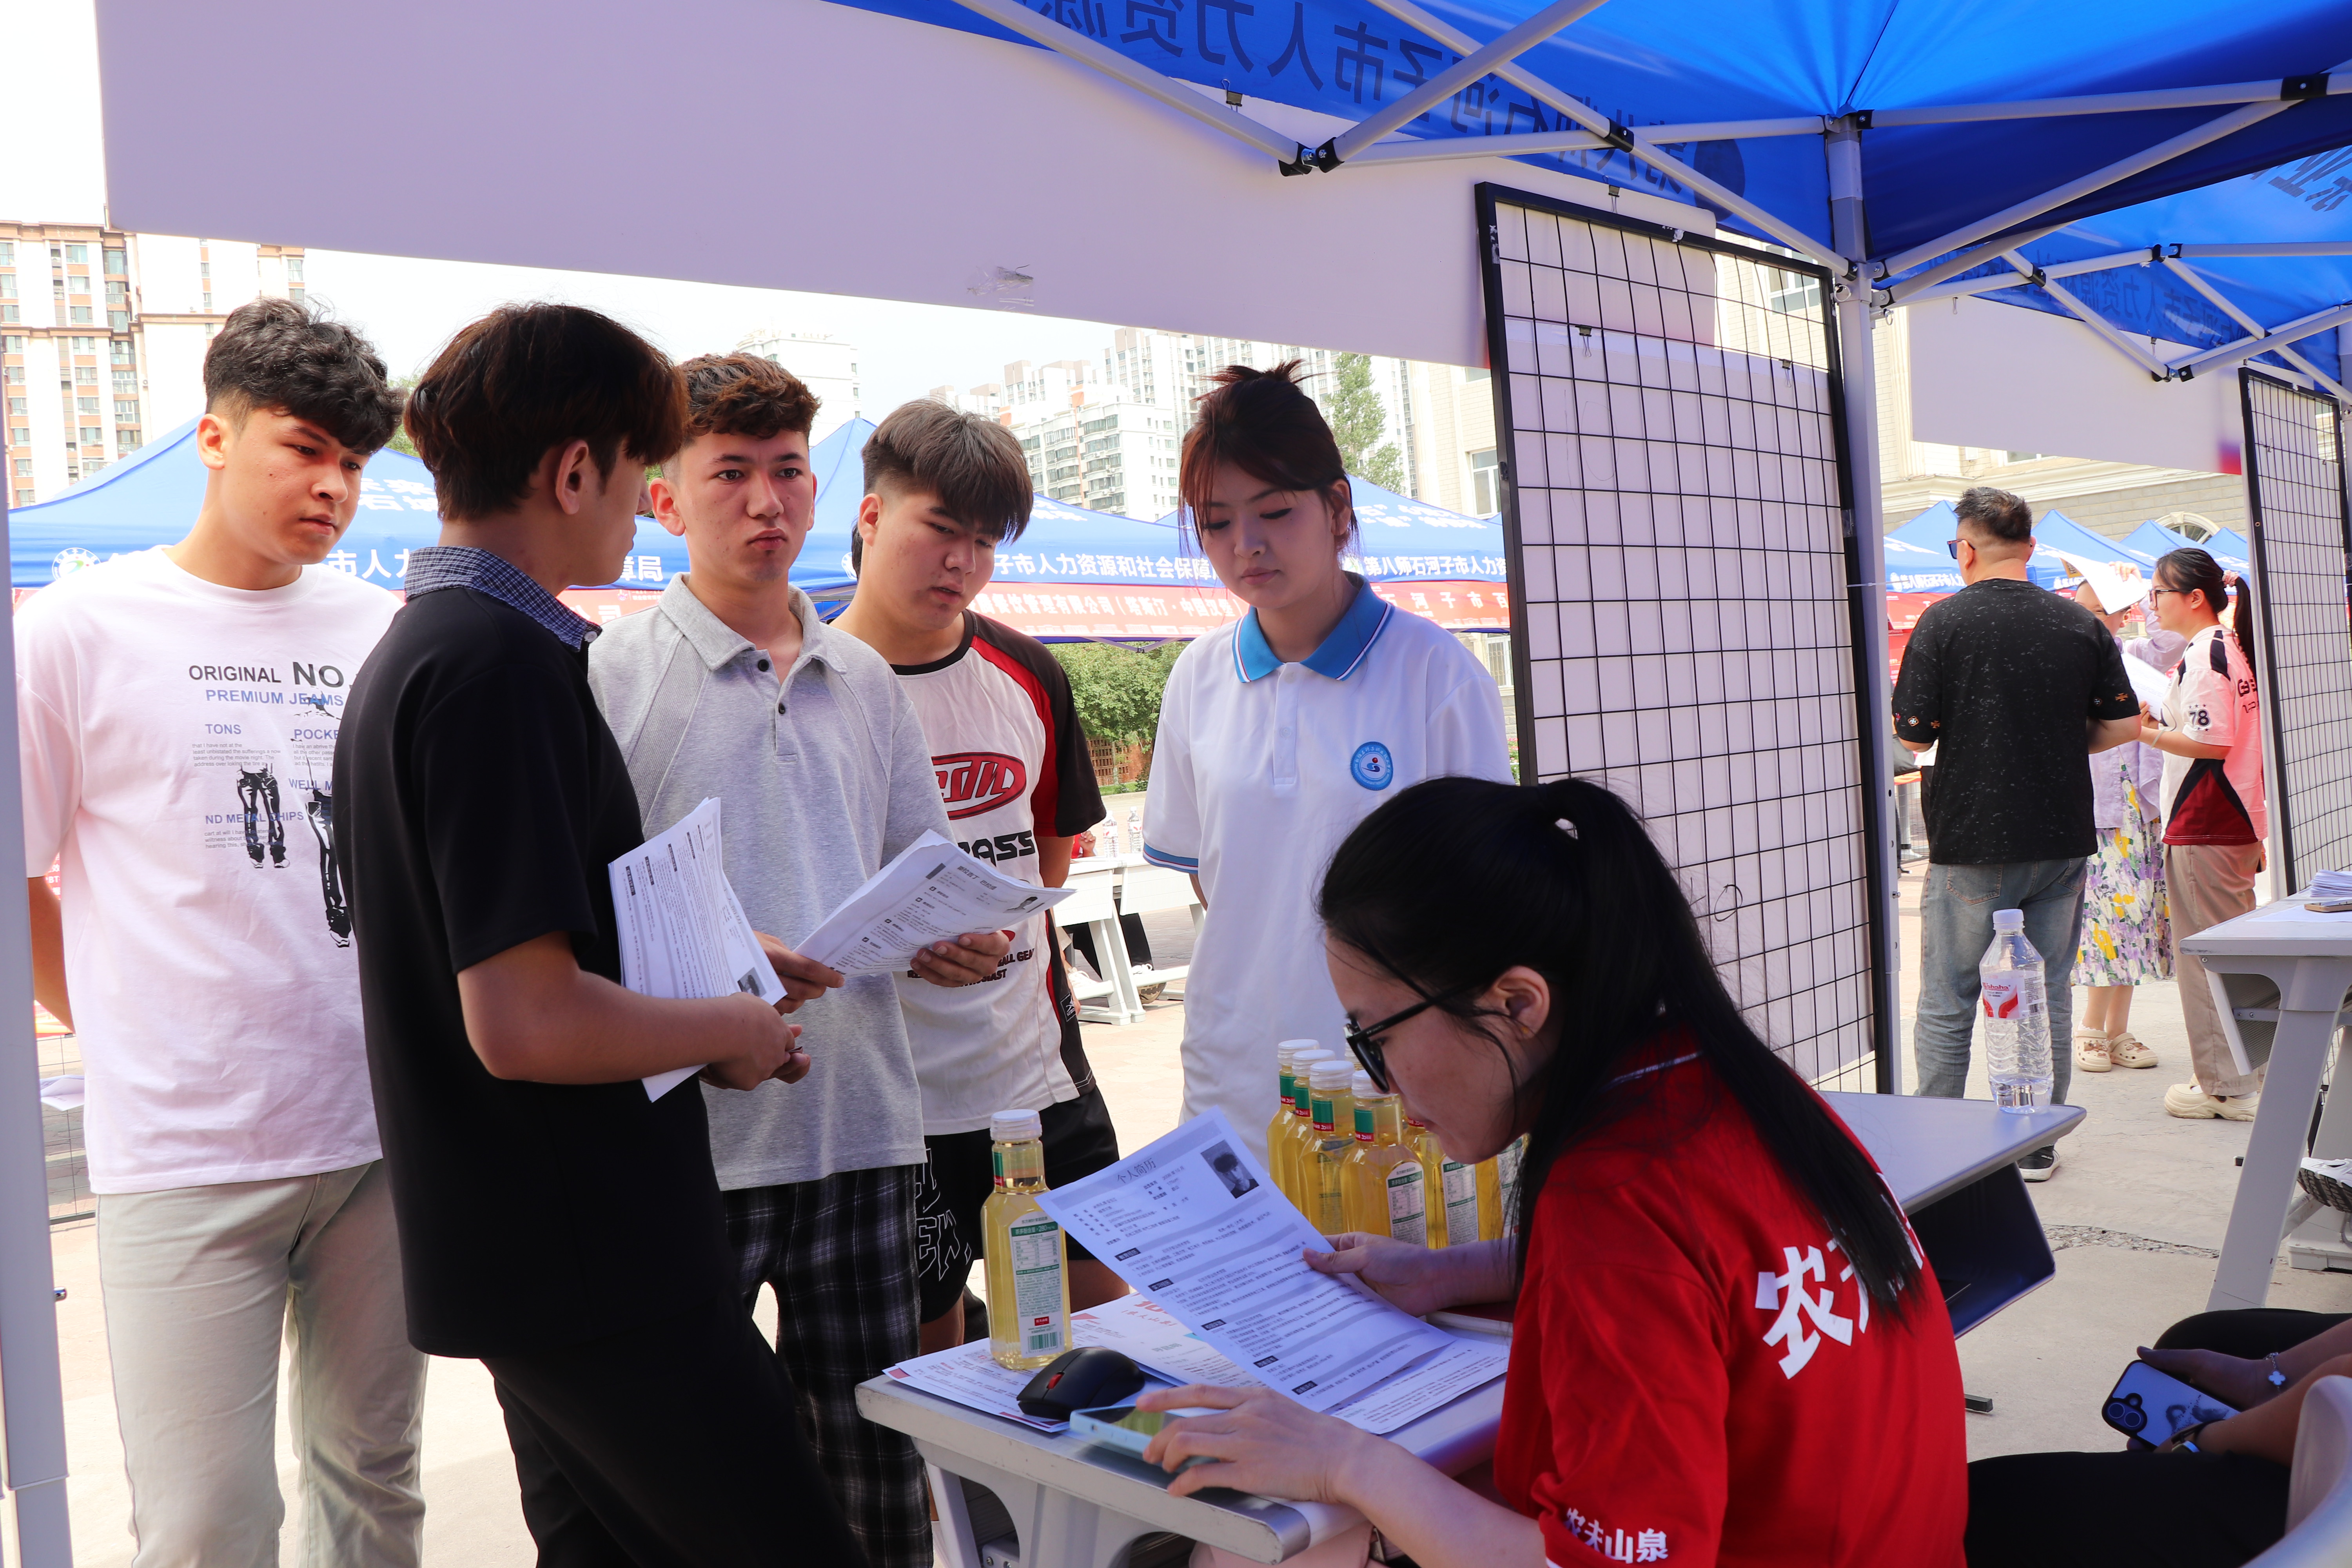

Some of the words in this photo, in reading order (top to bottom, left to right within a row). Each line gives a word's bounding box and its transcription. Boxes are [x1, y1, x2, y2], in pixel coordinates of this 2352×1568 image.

[994, 552, 1221, 581] 子市人力资源和社会保障
[189, 665, 282, 683] ORIGINAL
[205, 689, 284, 704] PREMIUM
[289, 693, 344, 706] JEAMS
[2189, 710, 2210, 727] 78
[205, 724, 242, 735] TONS
[289, 778, 321, 790] WELL
[205, 814, 223, 824] ND
[226, 813, 266, 824] METAL
[270, 811, 304, 822] CHIPS
[1117, 1157, 1156, 1184] 个人简历
[1563, 1507, 1669, 1564] 农夫山泉
